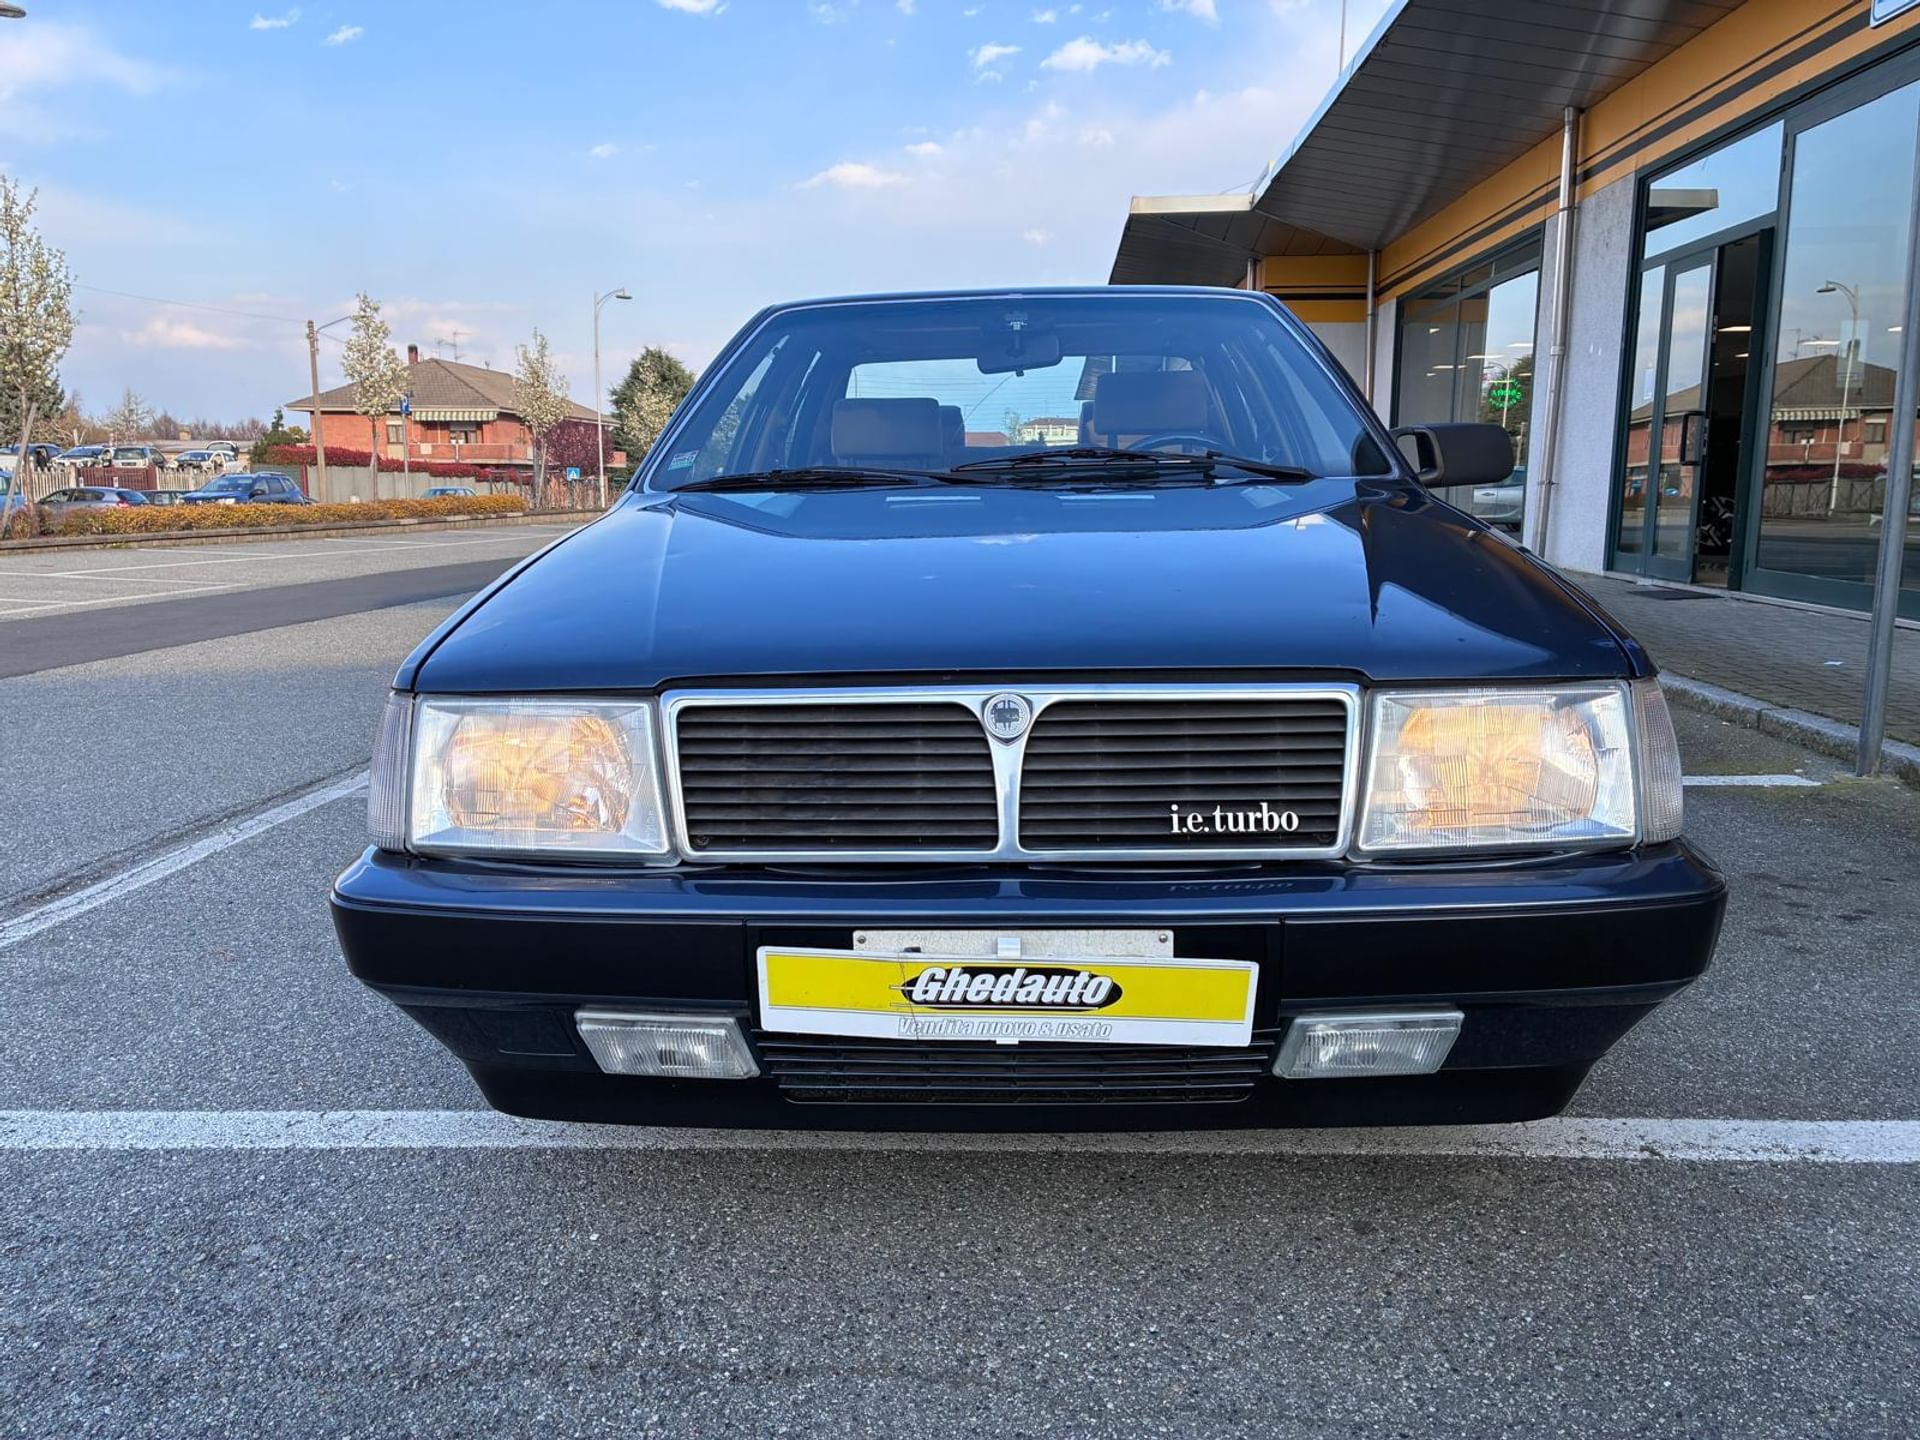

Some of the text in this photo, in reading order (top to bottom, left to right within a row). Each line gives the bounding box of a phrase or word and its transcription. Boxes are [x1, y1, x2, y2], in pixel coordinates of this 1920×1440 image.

[912, 967, 1114, 1005] Ghedauto
[899, 1016, 1112, 1038] Vendita nuovo & usato
